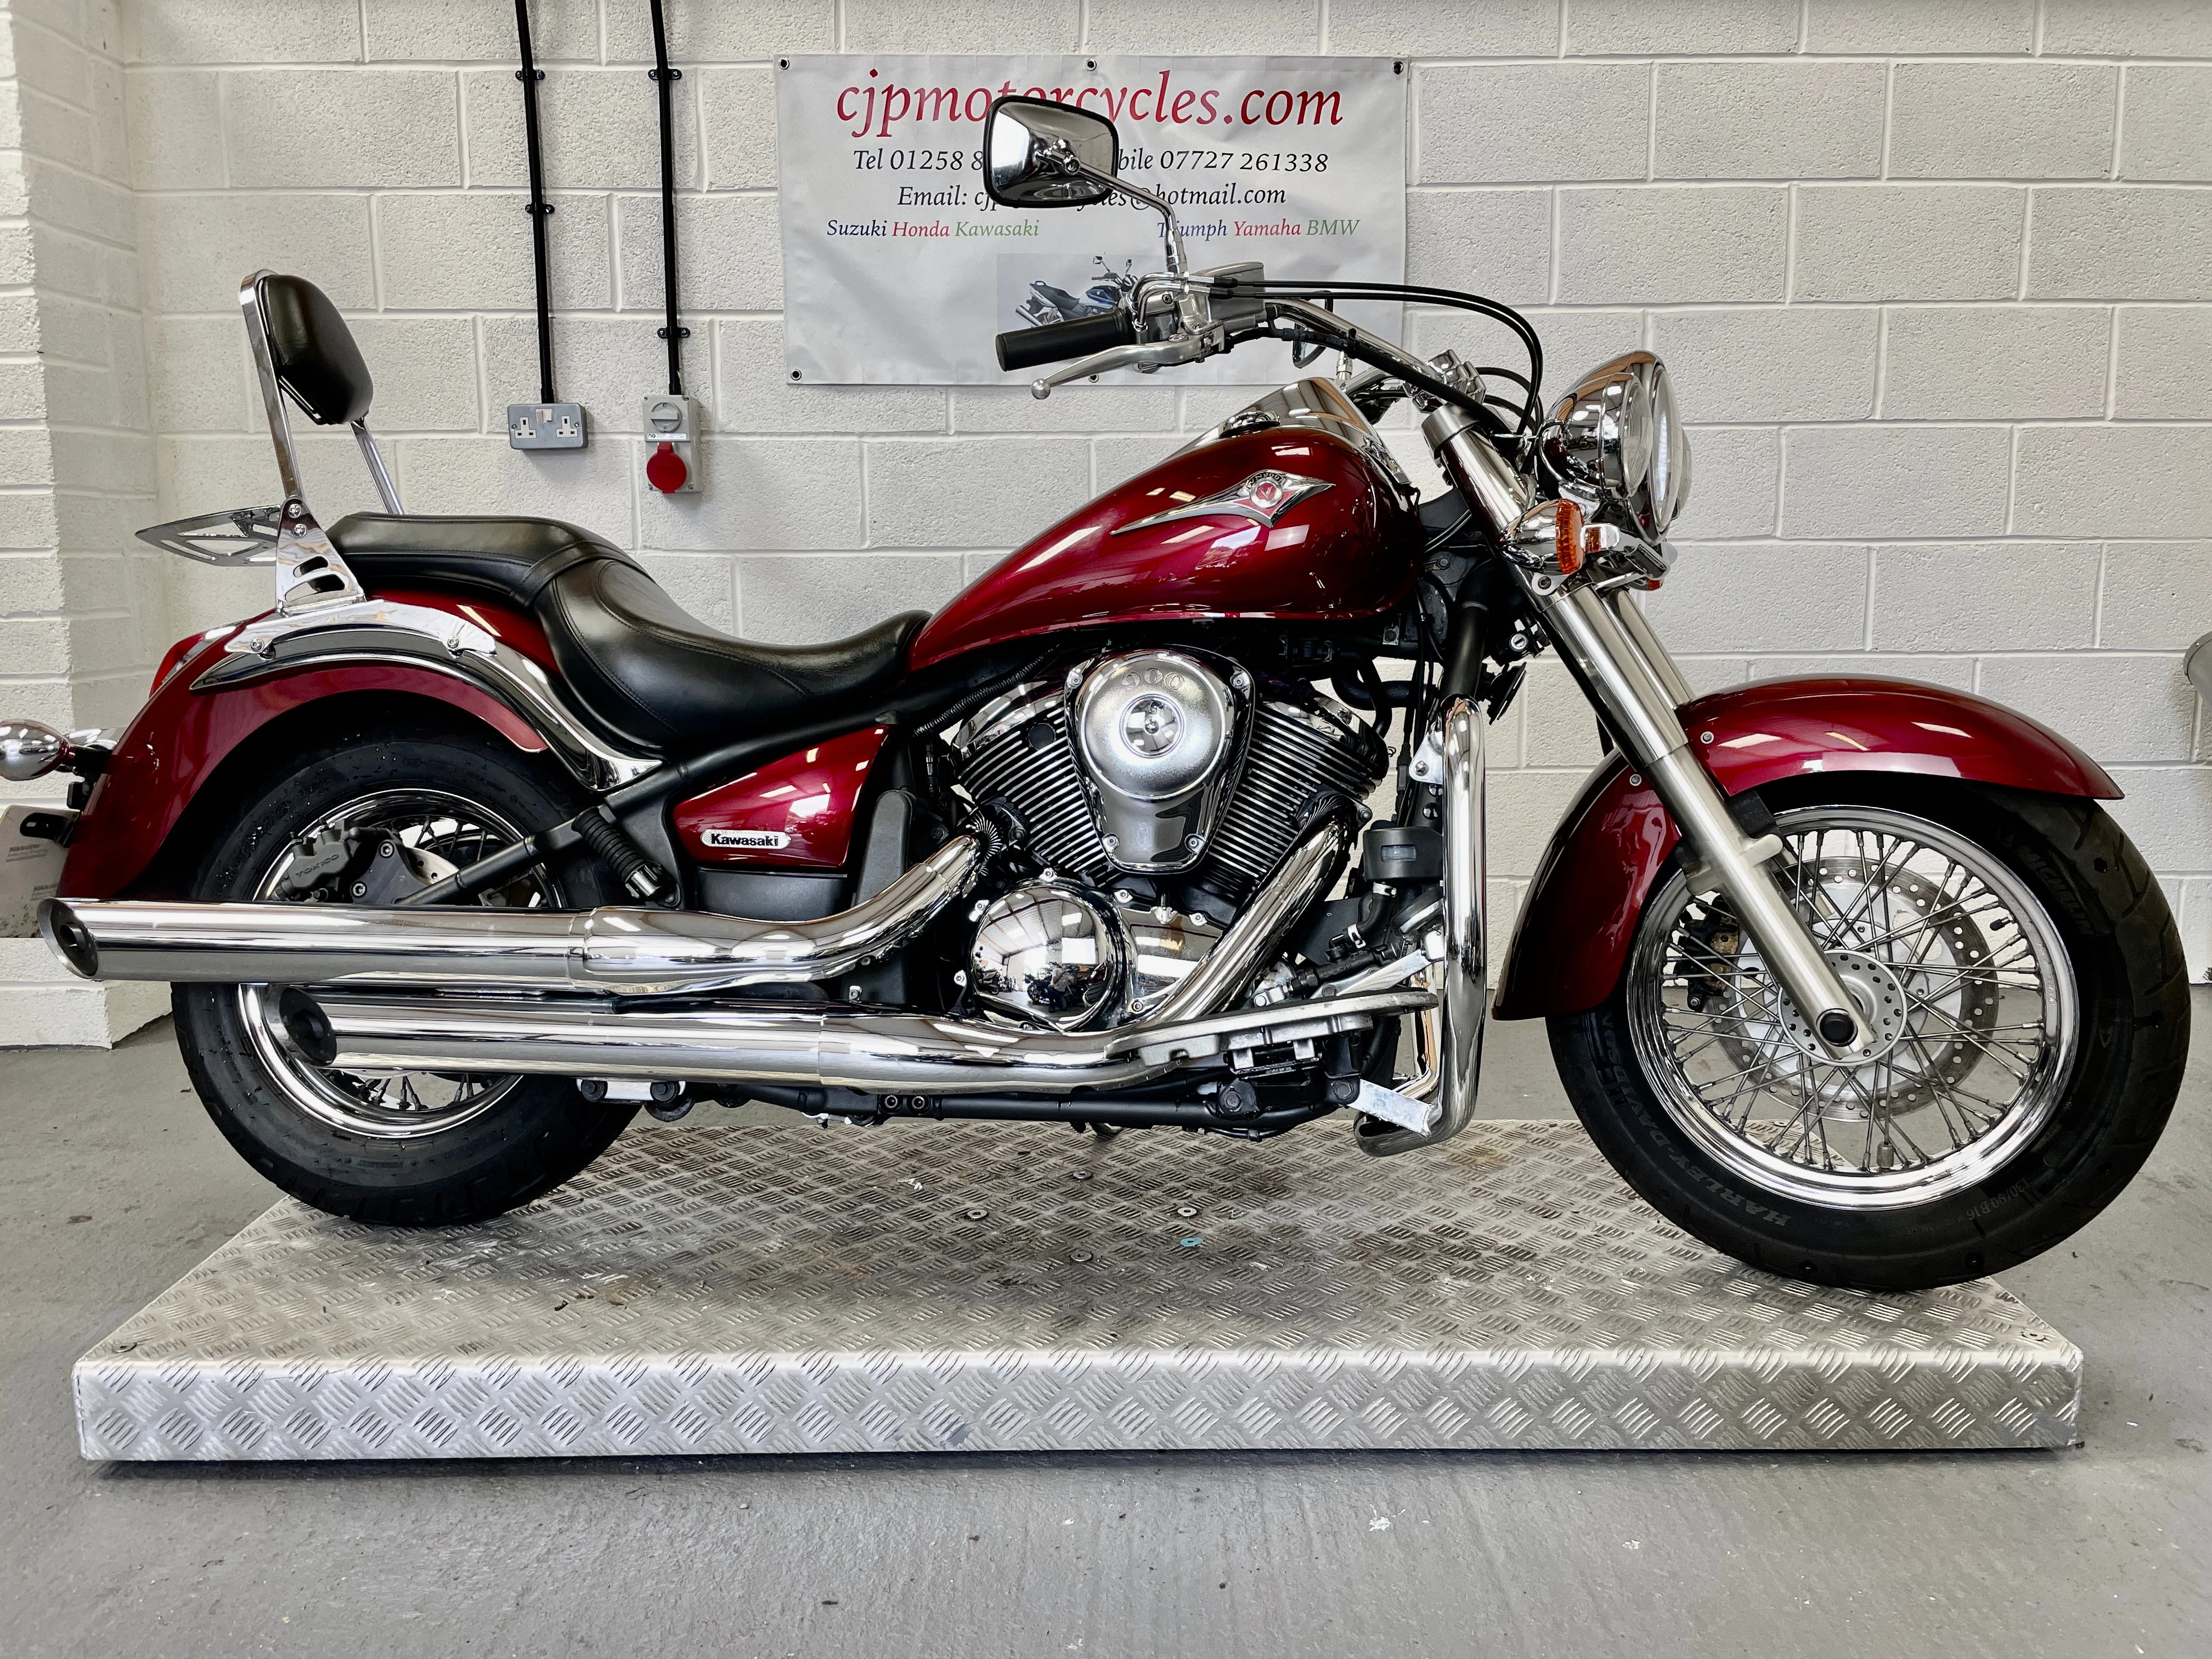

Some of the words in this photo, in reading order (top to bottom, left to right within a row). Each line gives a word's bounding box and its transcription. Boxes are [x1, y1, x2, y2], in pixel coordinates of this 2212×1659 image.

[837, 69, 1344, 138] cjpmorcycles.com
[854, 148, 884, 170] Tel
[890, 150, 964, 171] 01258
[1119, 147, 1154, 170] bile
[1160, 150, 1234, 170] 07727
[1239, 153, 1329, 172] 261338
[898, 184, 968, 206] Email:
[827, 219, 887, 237] Suzuki
[891, 221, 950, 237] Honda
[954, 219, 1040, 237] Kawasaki
[1157, 219, 1227, 241] Tumph
[1234, 218, 1302, 236] Yamaha
[1306, 219, 1361, 236] BMW
[711, 833, 778, 847] Kawasaki
[296, 854, 339, 877] TOKICO
